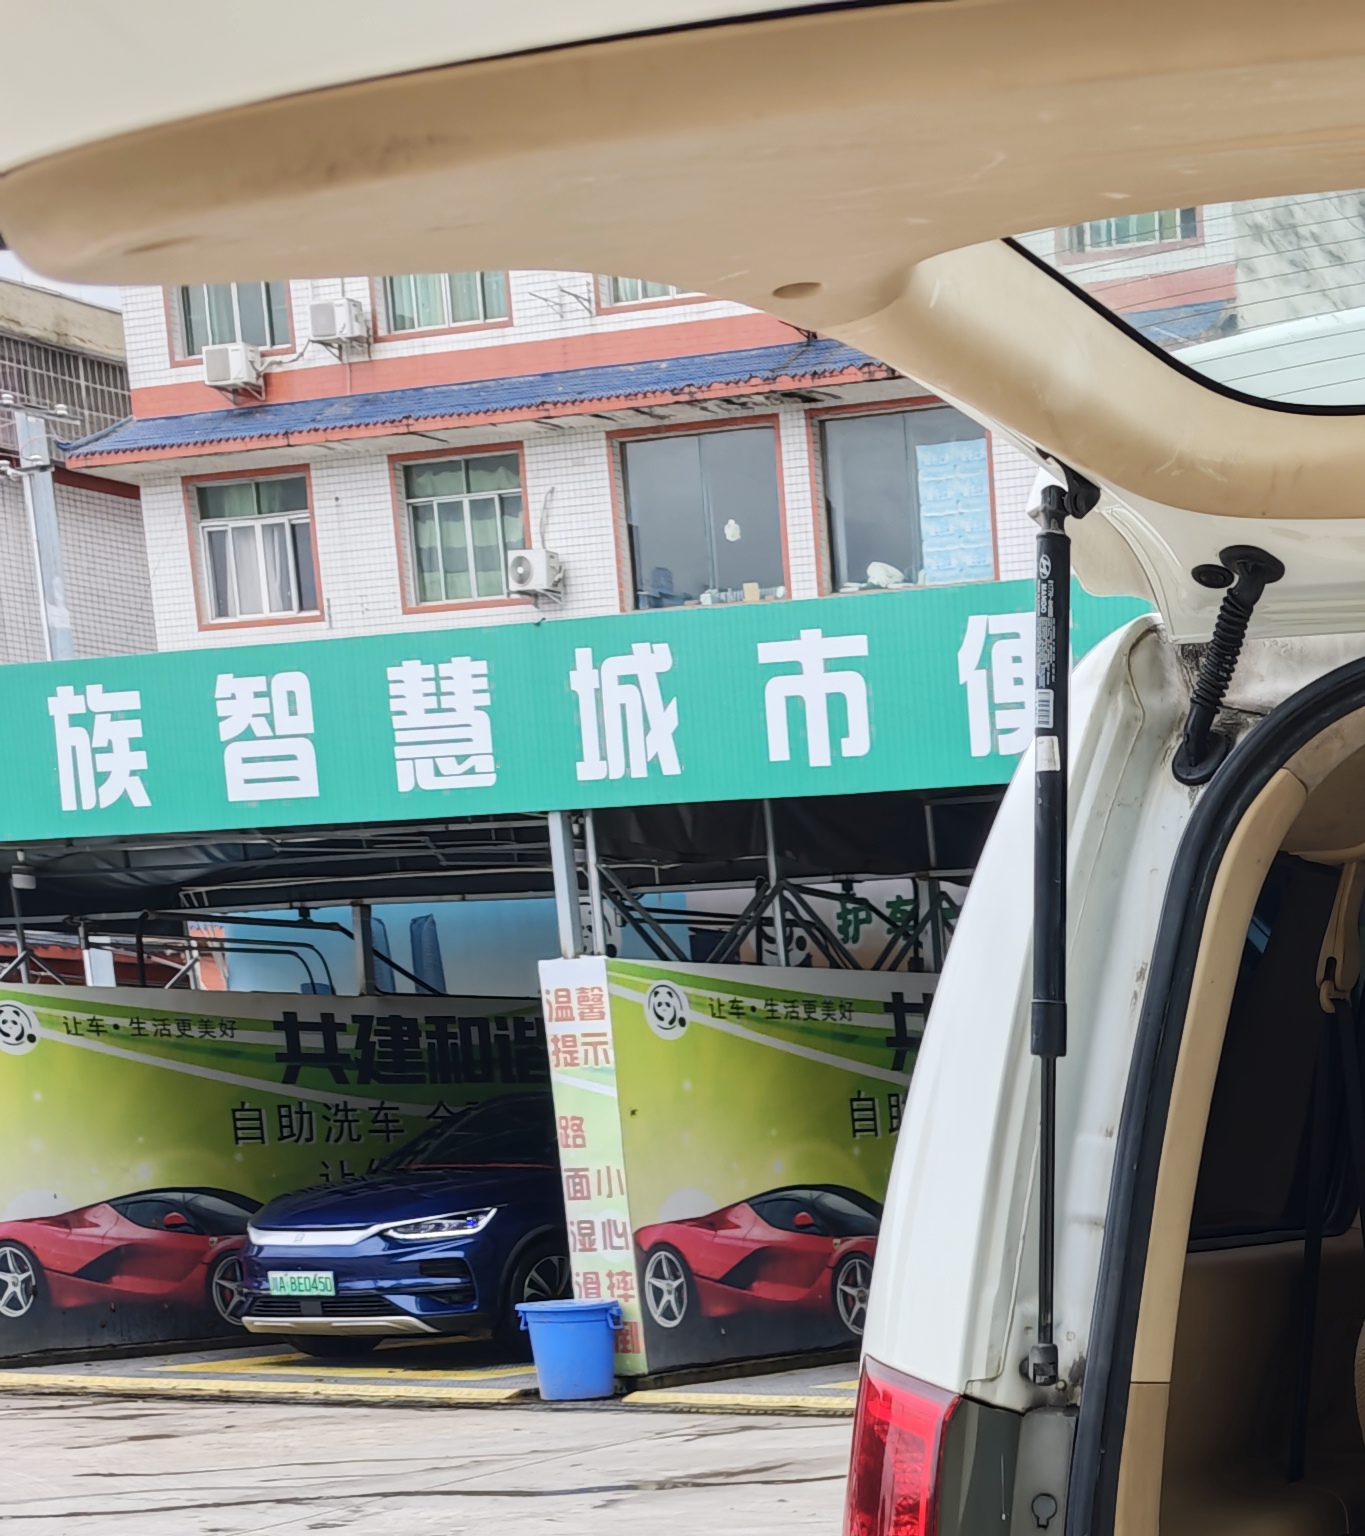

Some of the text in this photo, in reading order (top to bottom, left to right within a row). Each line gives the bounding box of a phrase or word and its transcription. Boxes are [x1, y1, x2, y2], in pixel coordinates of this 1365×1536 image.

[545, 986, 607, 1023] 温馨
[708, 996, 856, 1023] 让车·生活更美好
[62, 1015, 239, 1039] 让车·生活更美好
[550, 1032, 611, 1068] 提示
[231, 1100, 406, 1146] 自助洗车
